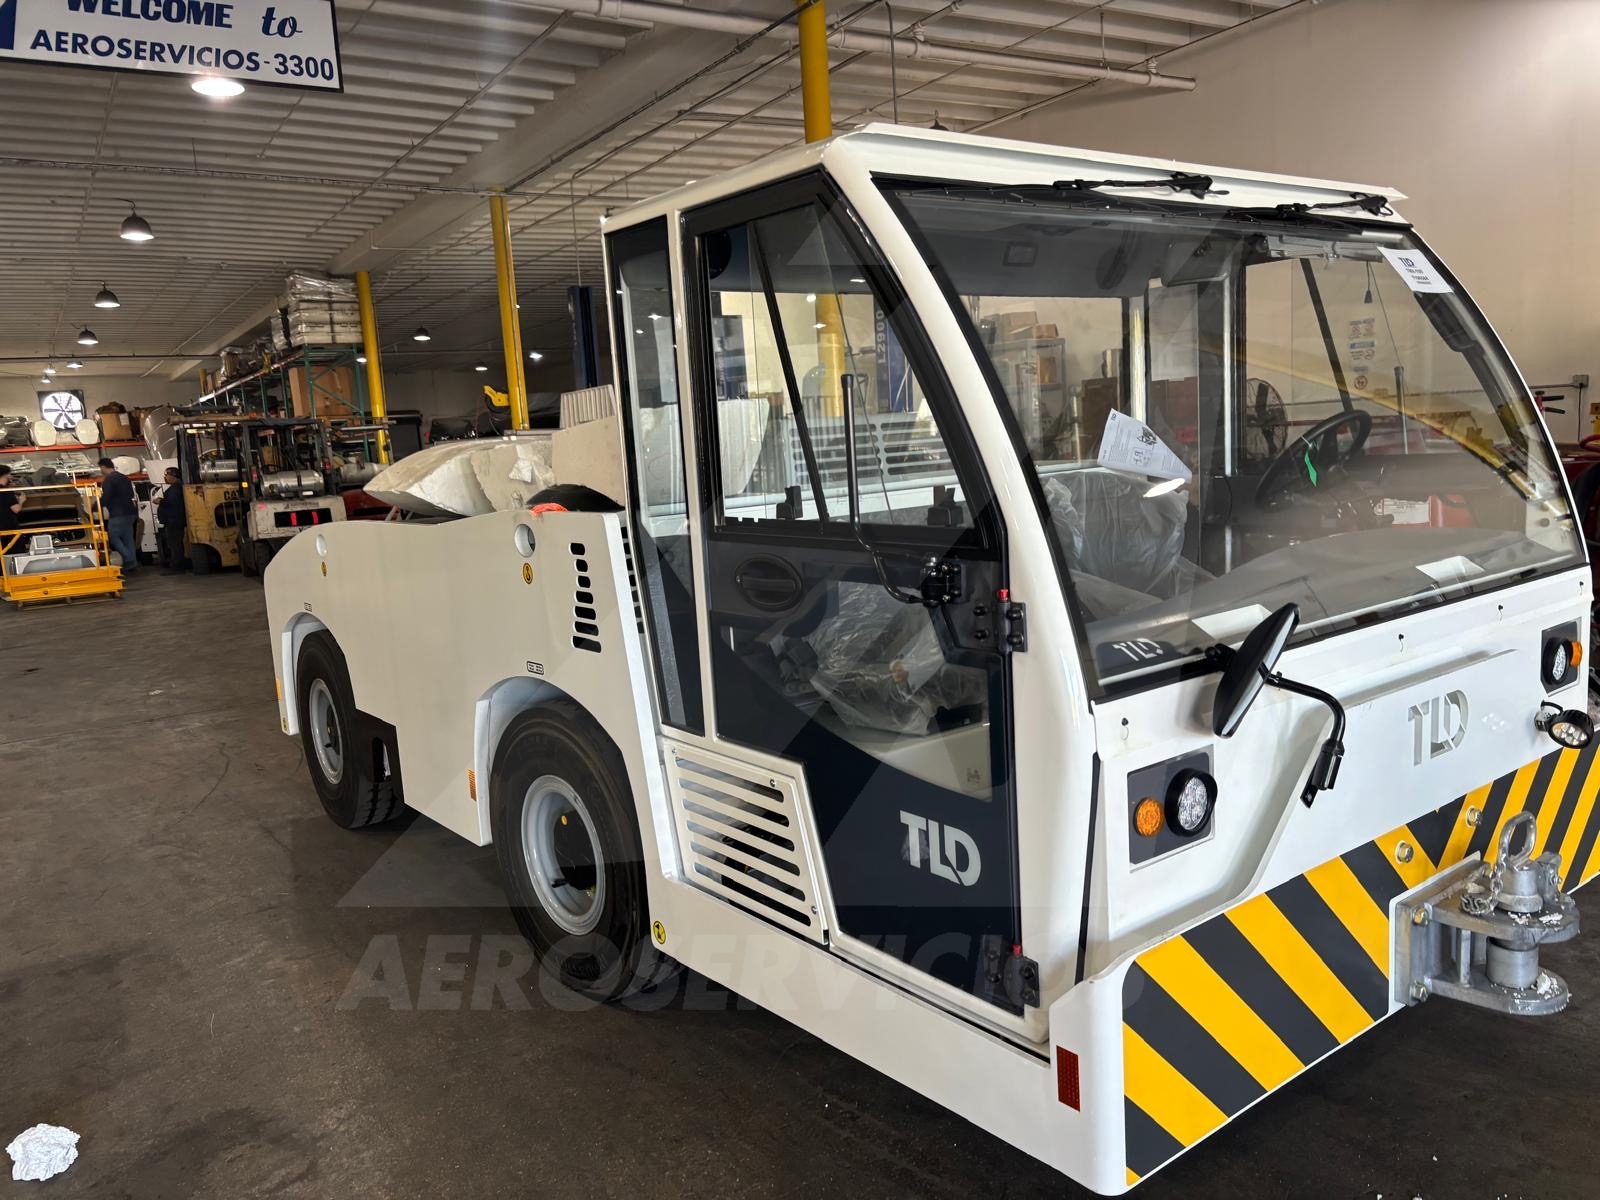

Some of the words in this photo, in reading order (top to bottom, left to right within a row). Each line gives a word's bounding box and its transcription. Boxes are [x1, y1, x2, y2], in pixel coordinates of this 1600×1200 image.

[261, 7, 303, 38] to
[876, 309, 887, 364] L2900
[1112, 638, 1164, 661] TLD
[1407, 690, 1469, 767] TLD
[899, 809, 982, 887] TLD
